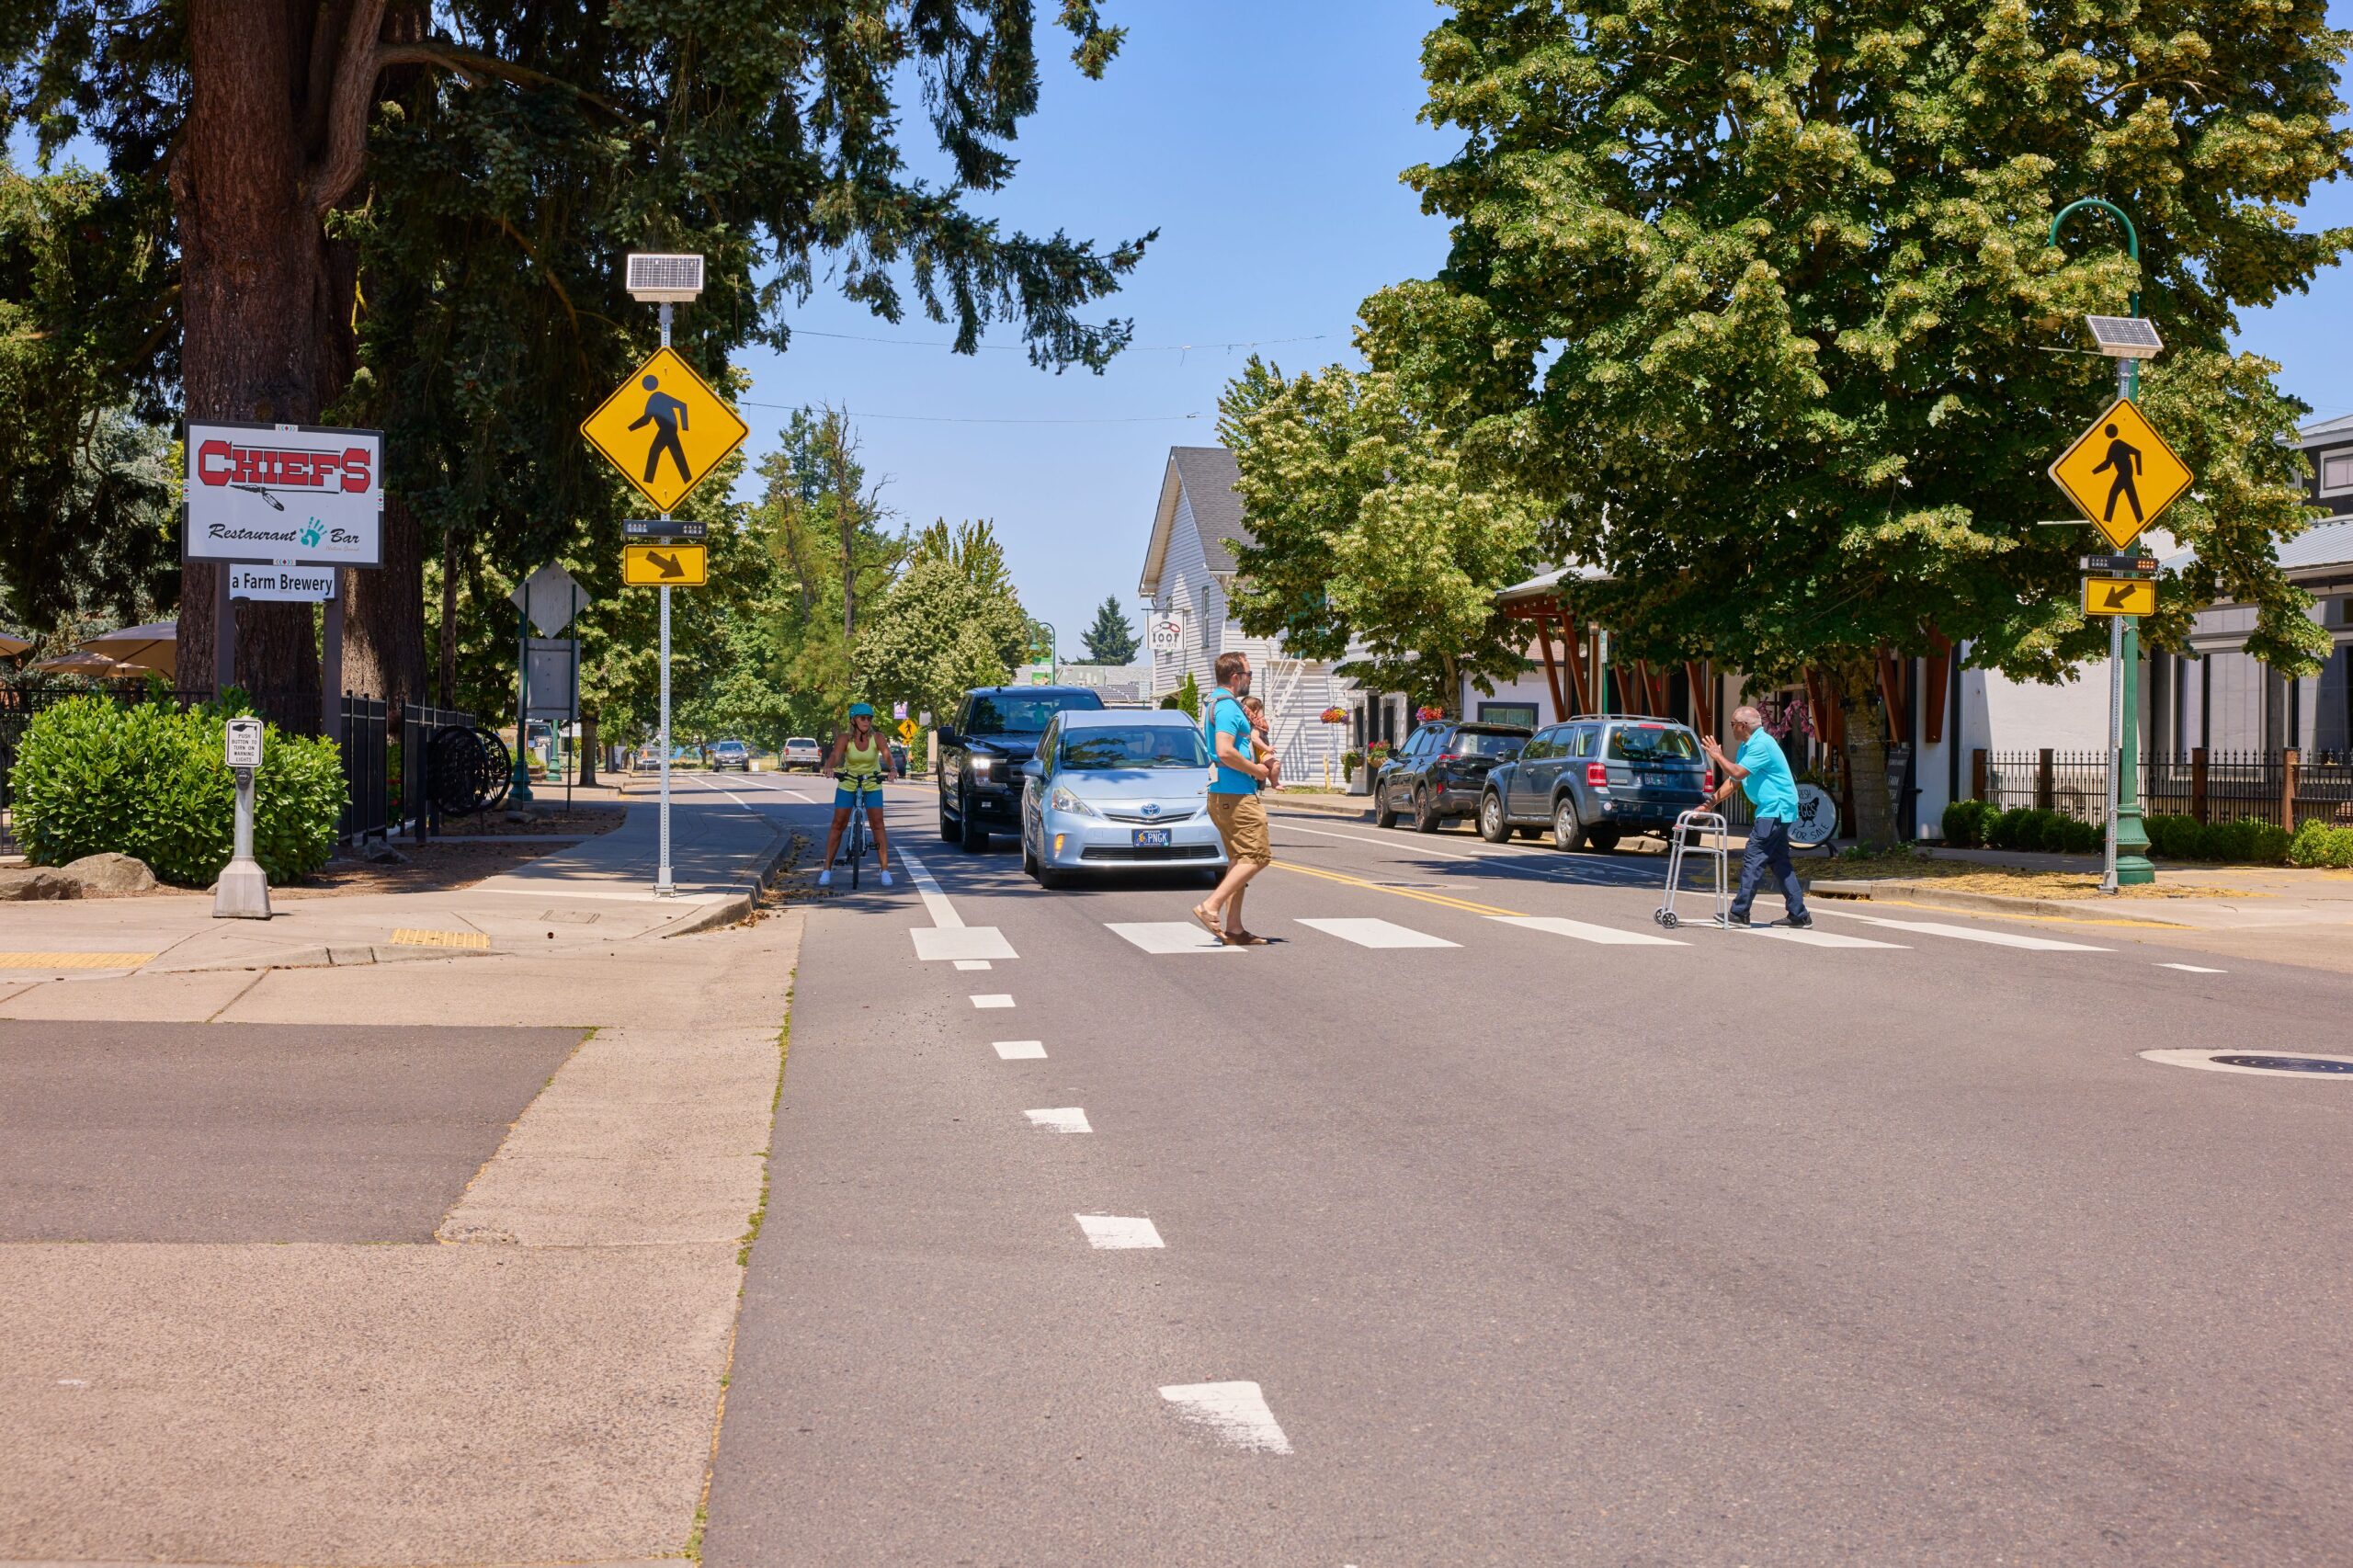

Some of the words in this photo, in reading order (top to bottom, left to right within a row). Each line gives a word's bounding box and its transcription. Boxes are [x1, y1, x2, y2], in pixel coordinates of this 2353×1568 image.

[198, 439, 371, 494] CHIEFS
[209, 523, 297, 541] Restaurant
[330, 528, 359, 543] Bar
[232, 576, 239, 589] a
[244, 573, 275, 589] Farm
[280, 574, 333, 596] Brewery
[1147, 833, 1167, 843] PNGK
[1791, 827, 1807, 840] FOR
[1811, 823, 1829, 839] SALE
